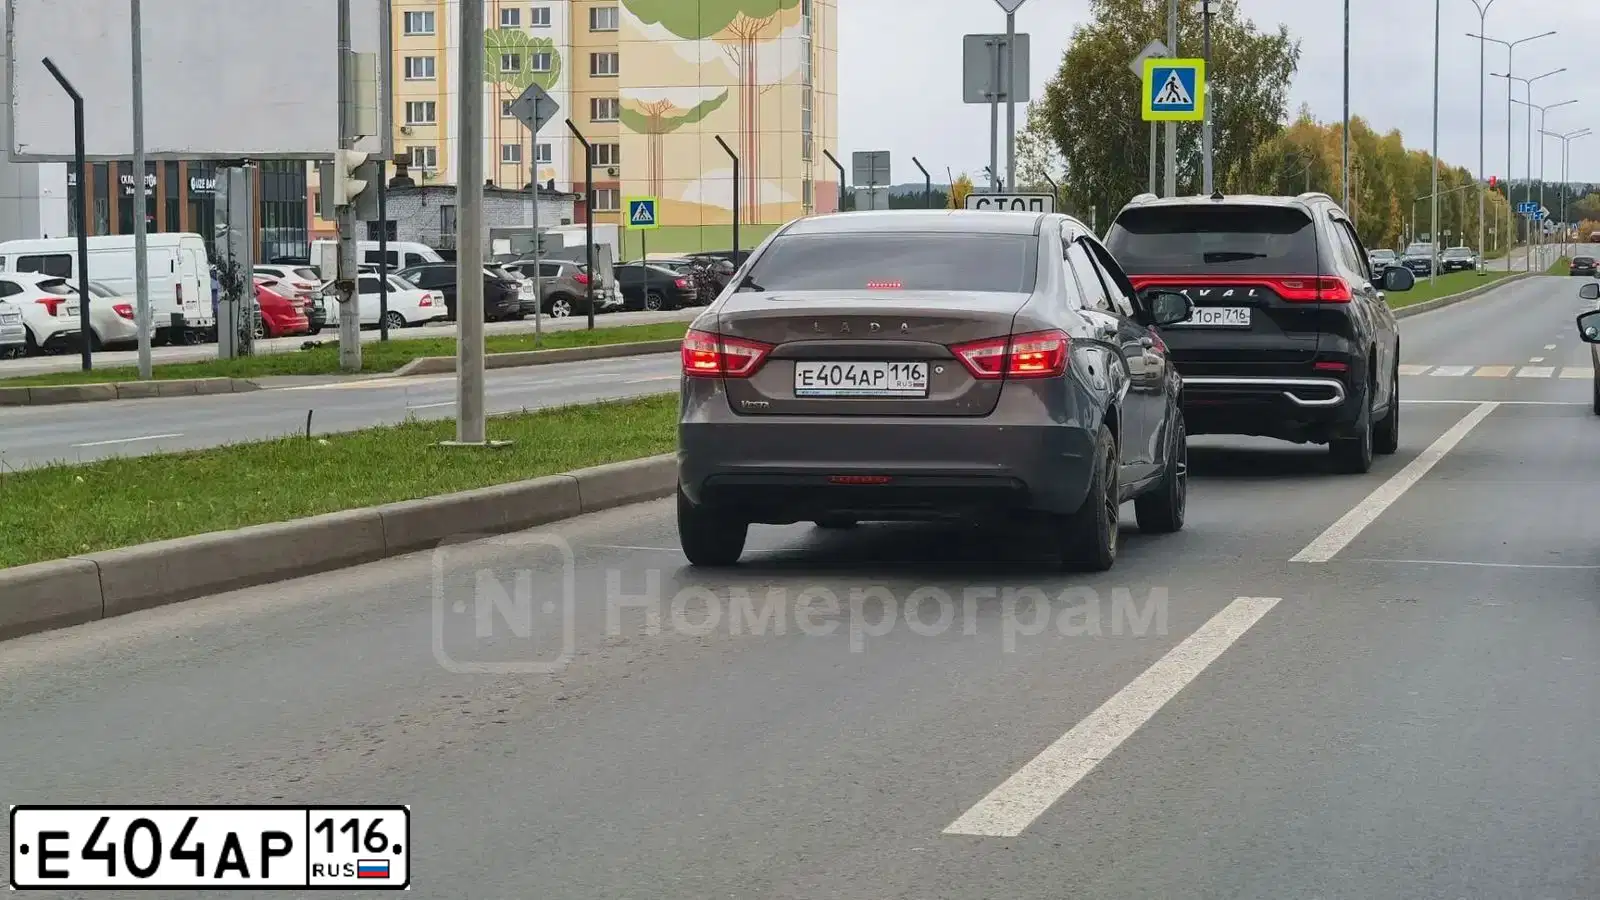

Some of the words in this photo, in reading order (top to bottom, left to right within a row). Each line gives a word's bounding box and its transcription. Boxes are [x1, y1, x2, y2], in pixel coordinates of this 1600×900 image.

[121, 174, 135, 185] СКЛА
[976, 197, 1043, 212] СТОП
[1180, 288, 1259, 297] AVAL
[1225, 309, 1246, 320] 716
[814, 321, 911, 334] LADA
[802, 365, 885, 386] Е404АР
[889, 364, 920, 380] 116
